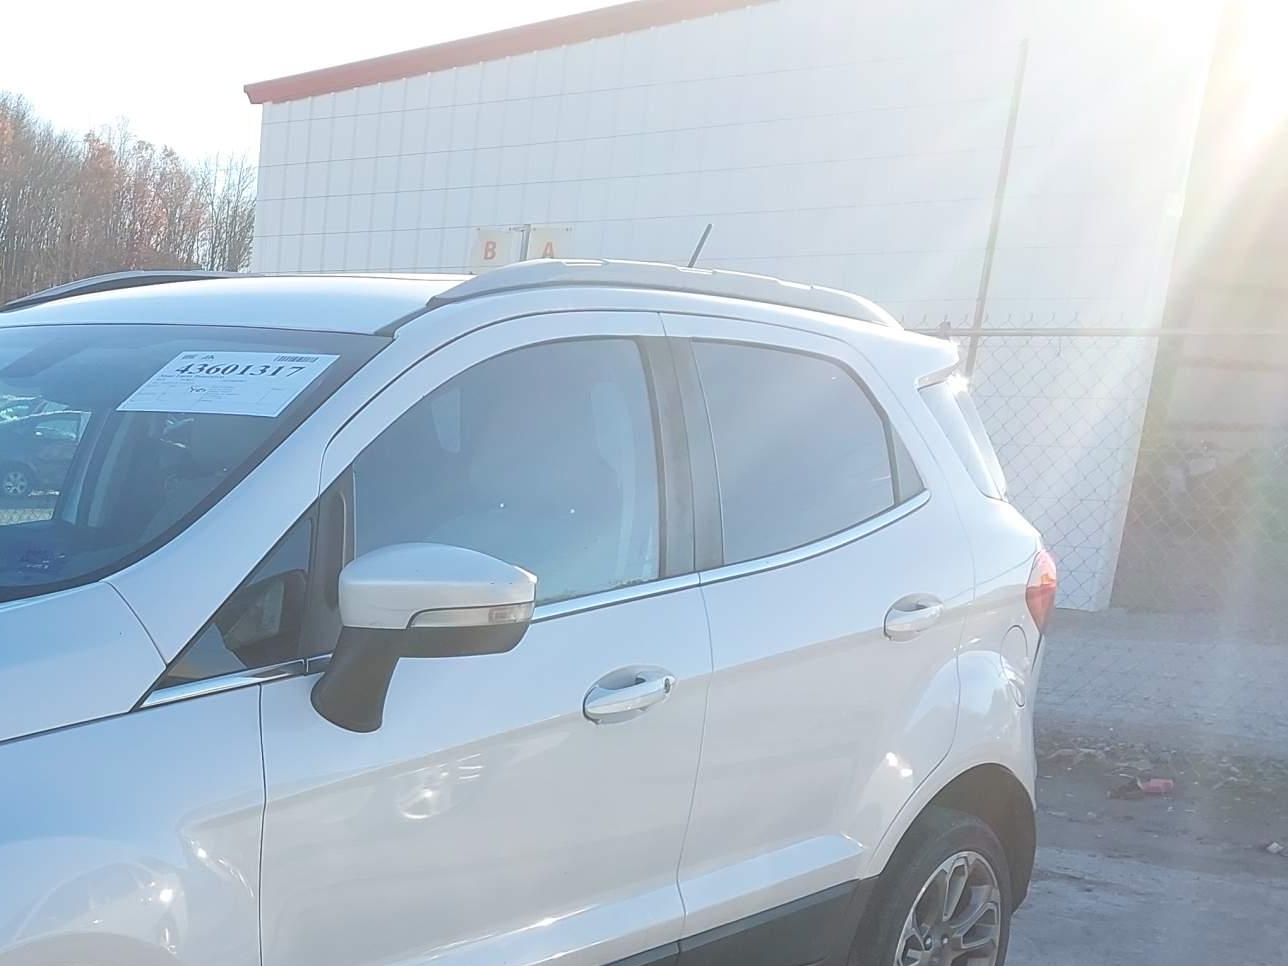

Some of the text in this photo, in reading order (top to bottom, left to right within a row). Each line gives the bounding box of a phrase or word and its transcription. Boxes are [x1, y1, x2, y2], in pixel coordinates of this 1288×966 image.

[483, 240, 497, 260] B
[542, 241, 555, 258] A
[176, 362, 306, 377] 43601317
